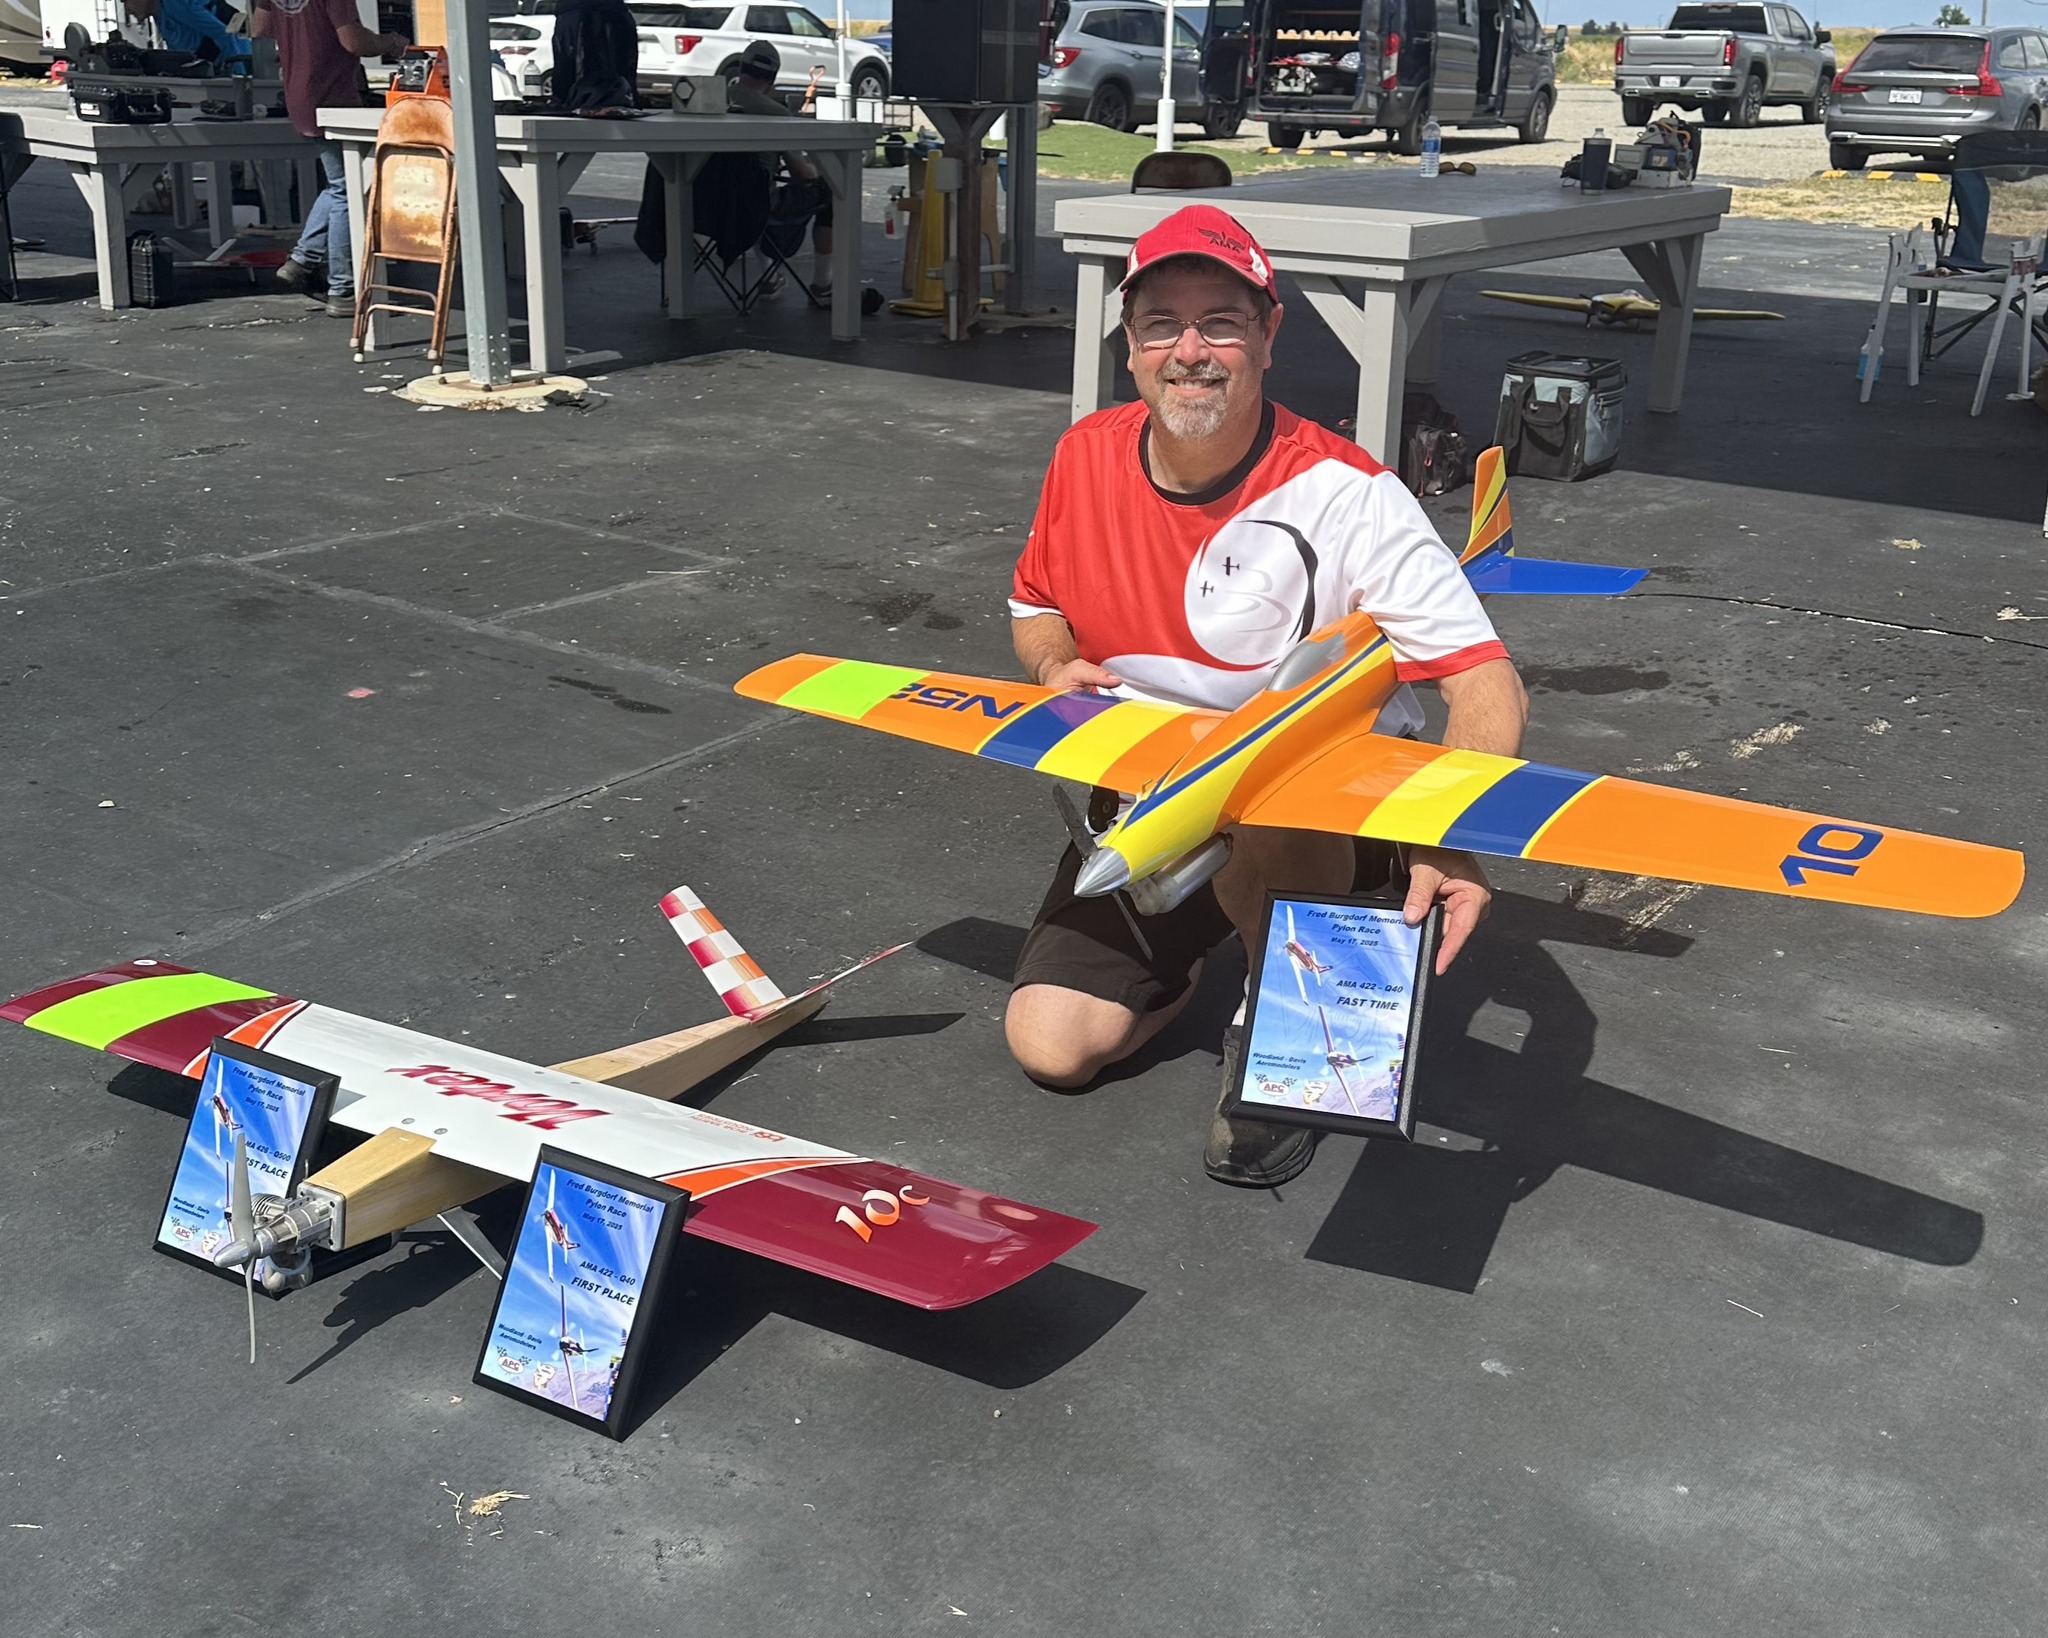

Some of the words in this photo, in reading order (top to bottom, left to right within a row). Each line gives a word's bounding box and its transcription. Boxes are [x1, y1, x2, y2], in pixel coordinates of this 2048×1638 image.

[1778, 823, 1884, 887] 10
[1306, 909, 1327, 919] Fred
[1327, 909, 1368, 924] Burgdorf
[1369, 915, 1406, 926] Memoria
[1331, 922, 1356, 934] Pylon
[1357, 925, 1381, 935] Race
[1330, 935, 1346, 944] May
[1359, 938, 1378, 947] 2025
[1335, 978, 1357, 989] AMA
[1358, 981, 1376, 990] 422
[1383, 983, 1403, 993] Q40
[1336, 995, 1368, 1007] FAST
[1368, 999, 1399, 1011] TIME
[1252, 1051, 1284, 1061] Woodland
[1287, 1056, 1307, 1064] Davis
[1255, 1058, 1300, 1070] Aeromodelers
[231, 1065, 248, 1077] Fred
[246, 1070, 276, 1088] Burgdorf
[275, 1080, 306, 1096] Memorial
[1262, 1082, 1285, 1093] APC
[265, 1089, 283, 1101] Race
[244, 1140, 256, 1149] MA
[272, 1149, 292, 1162] Q500
[259, 1162, 288, 1179] PLACE
[565, 1178, 585, 1190] Fred
[583, 1183, 619, 1203] Burgdorf
[617, 1195, 654, 1213] Memorial
[584, 1197, 607, 1212] Pylon
[606, 1205, 627, 1218] Race
[581, 1212, 596, 1223] May
[579, 1260, 598, 1272] AMA
[597, 1266, 614, 1278] 422
[618, 1274, 636, 1286] Q40
[570, 1276, 602, 1294] FIRST
[600, 1287, 635, 1306] PLACE
[500, 1357, 520, 1371] APC
